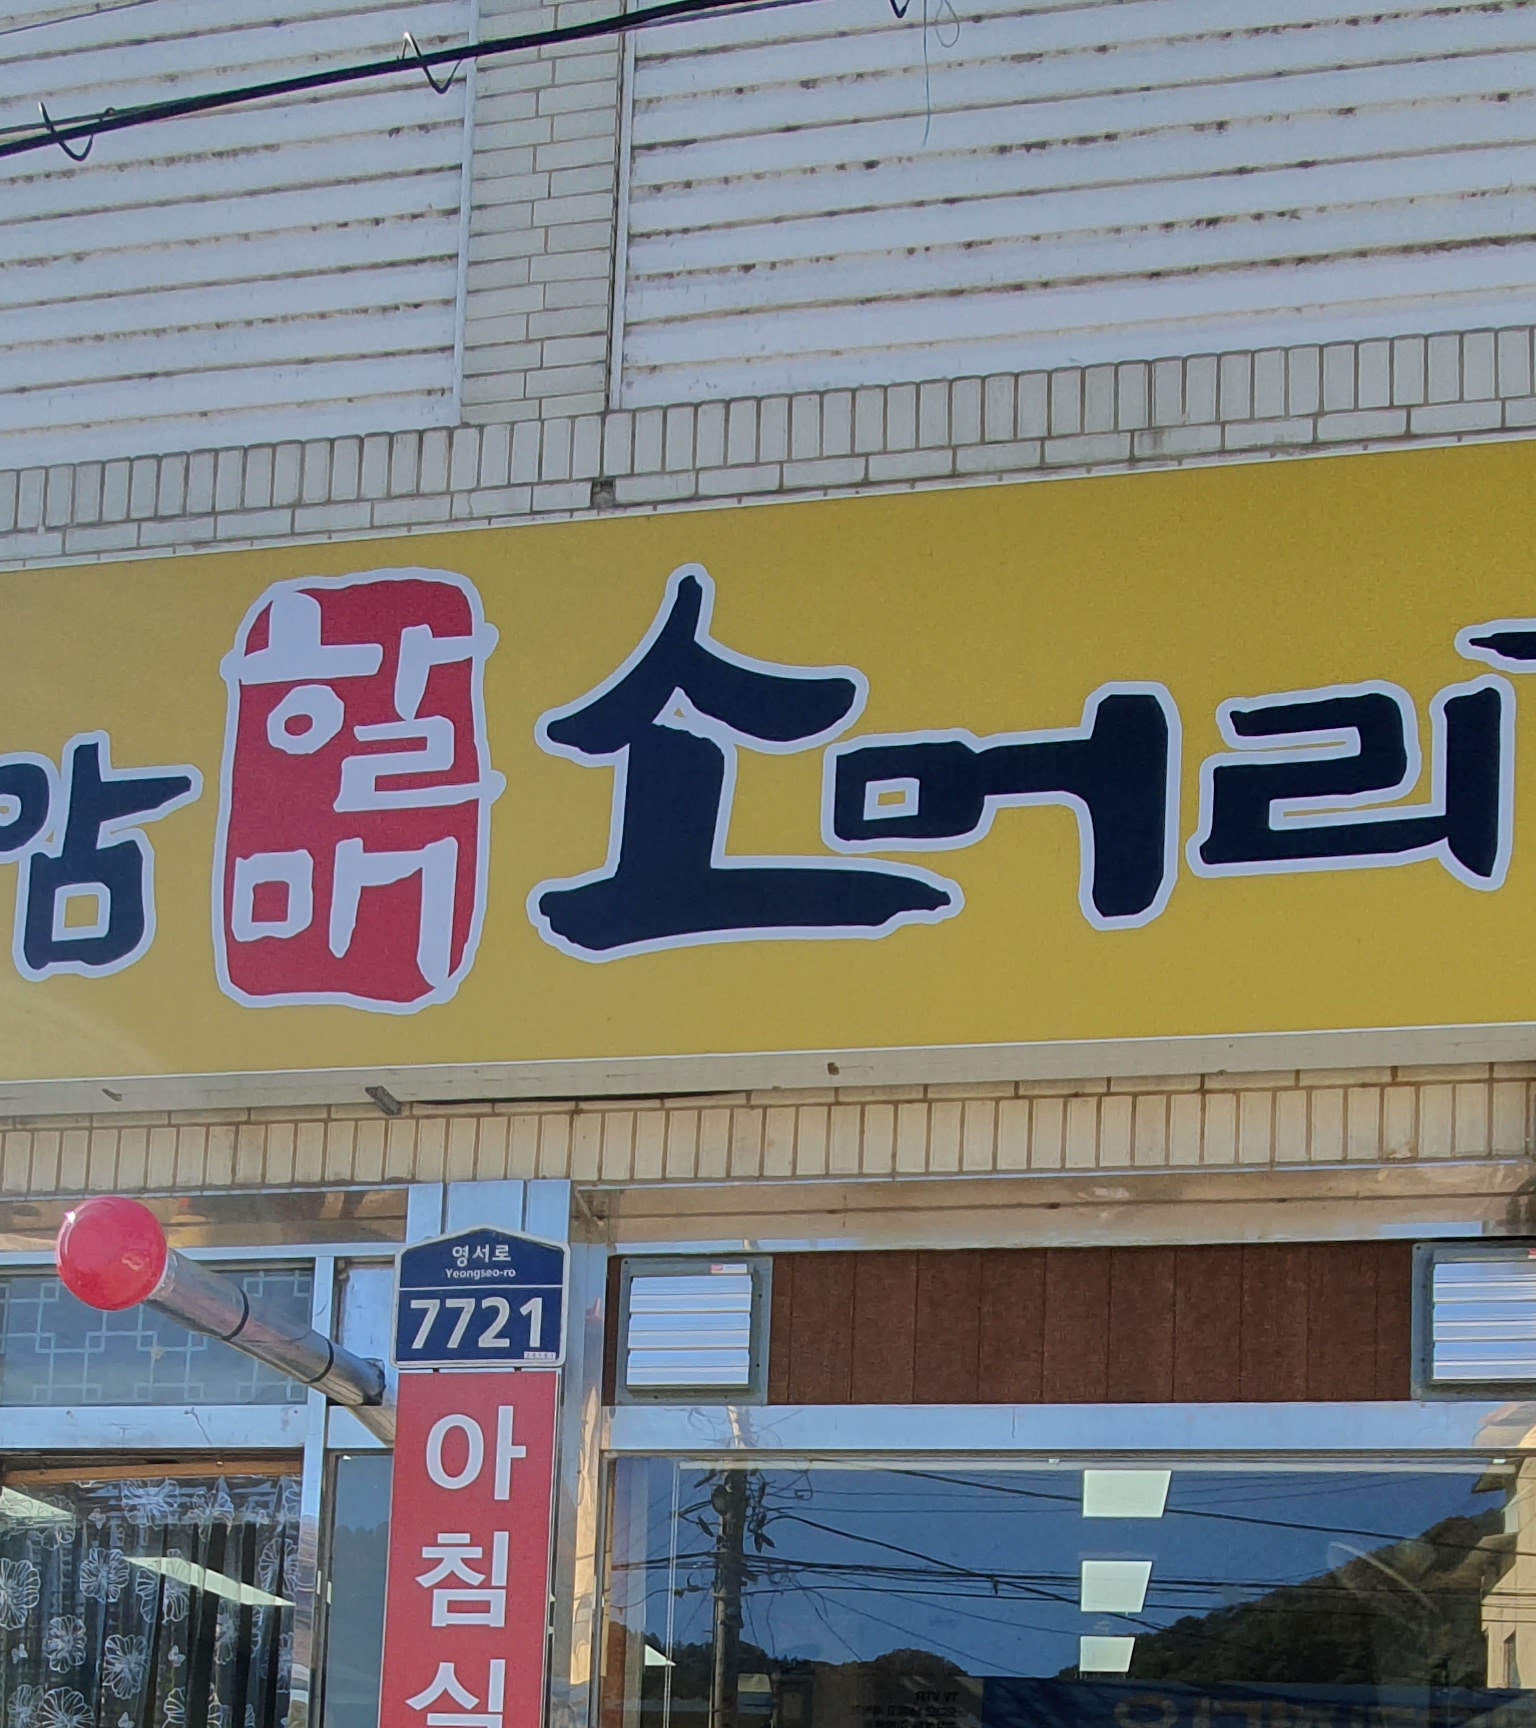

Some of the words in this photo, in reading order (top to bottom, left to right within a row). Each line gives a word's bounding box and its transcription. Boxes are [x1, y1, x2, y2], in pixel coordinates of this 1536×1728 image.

[220, 588, 504, 994] 할매
[452, 1244, 511, 1267] 영서로
[445, 1268, 516, 1281] Yeongseo-ro
[410, 1297, 543, 1349] 7721
